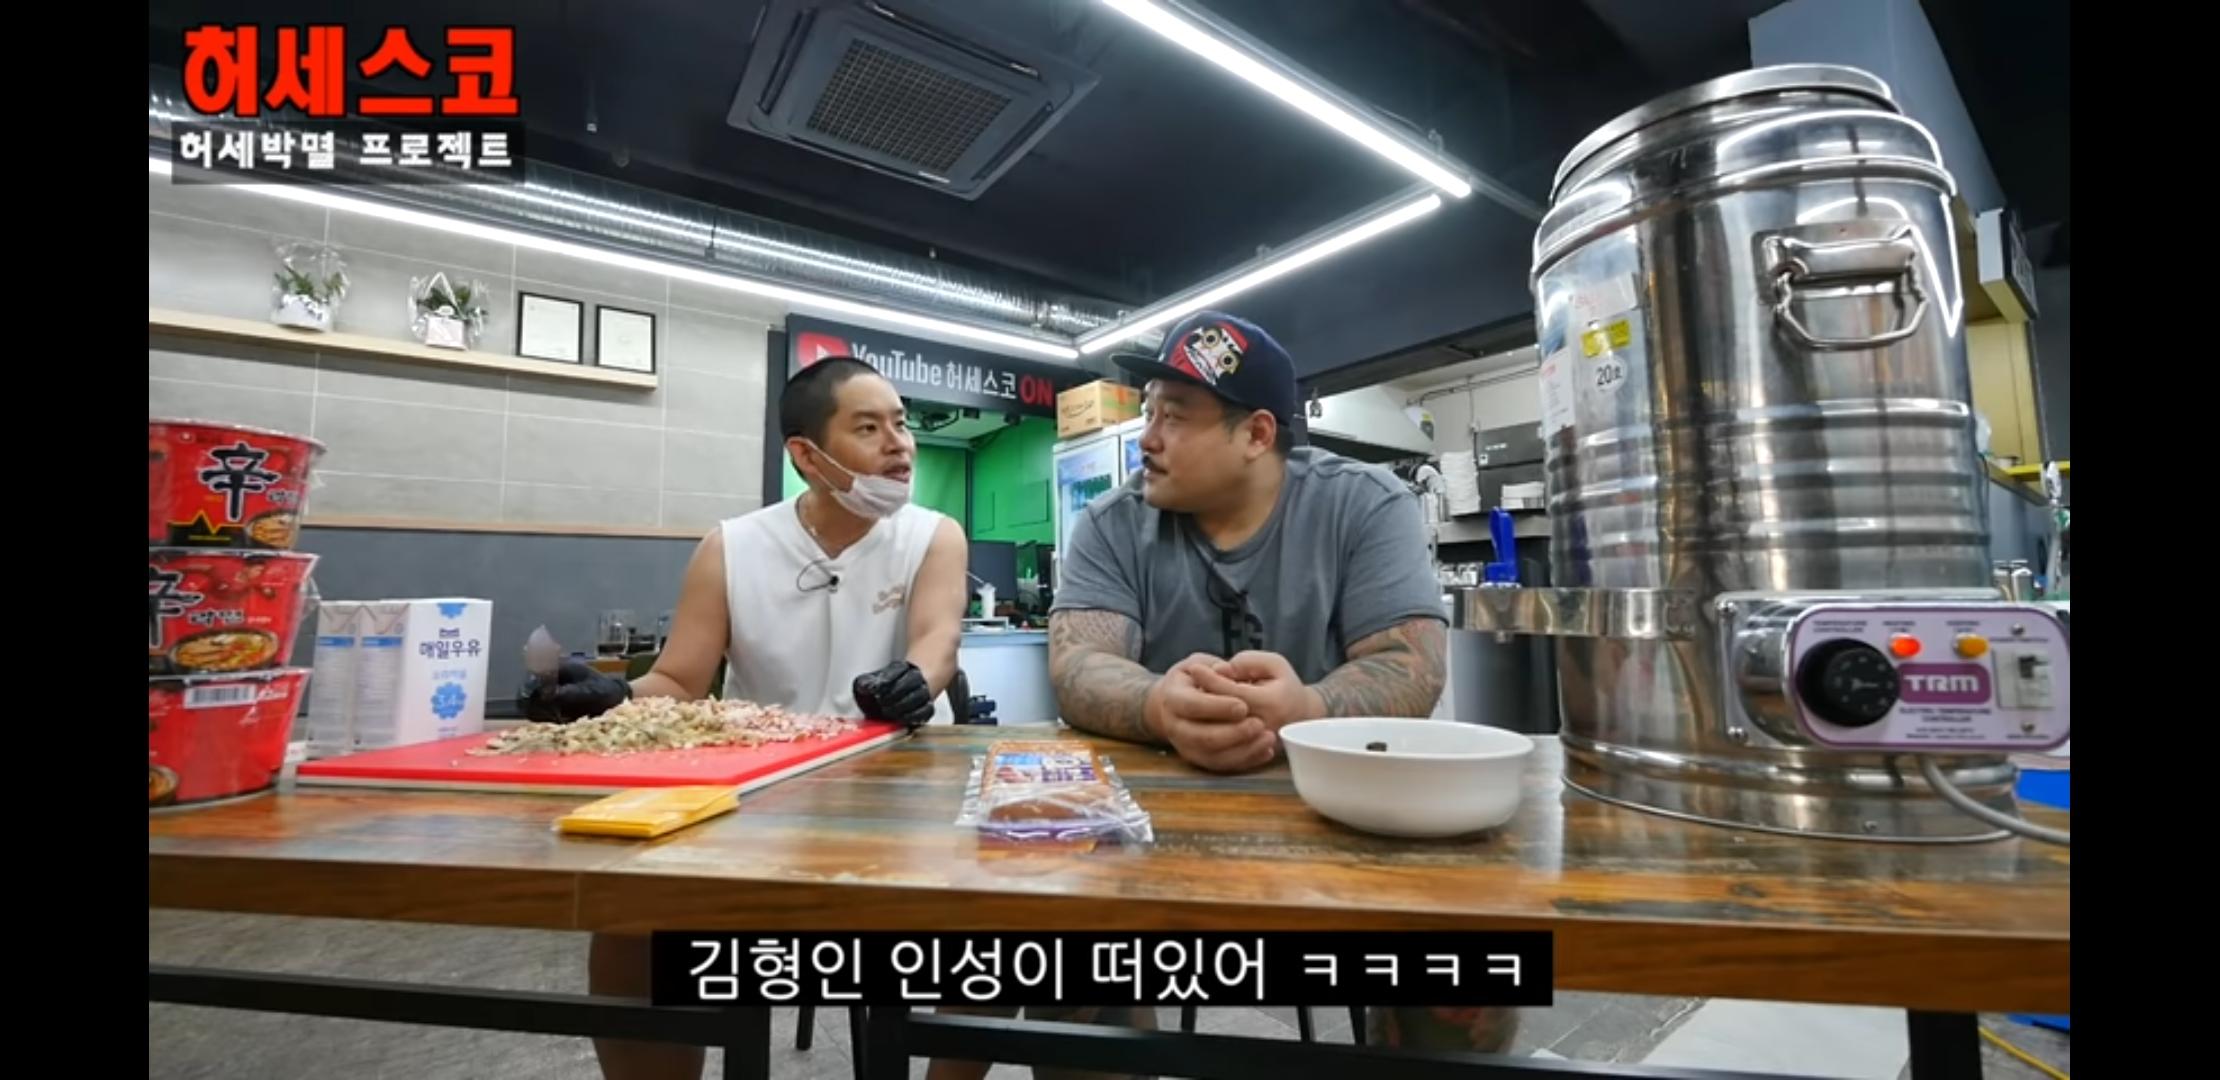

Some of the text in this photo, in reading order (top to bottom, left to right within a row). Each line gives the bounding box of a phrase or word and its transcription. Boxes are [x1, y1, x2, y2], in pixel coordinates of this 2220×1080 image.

[852, 343, 1056, 406] YouTube 허세스코 ON
[200, 441, 282, 521] 辛
[419, 639, 482, 659] 매일우유
[1903, 674, 1980, 693] TRM
